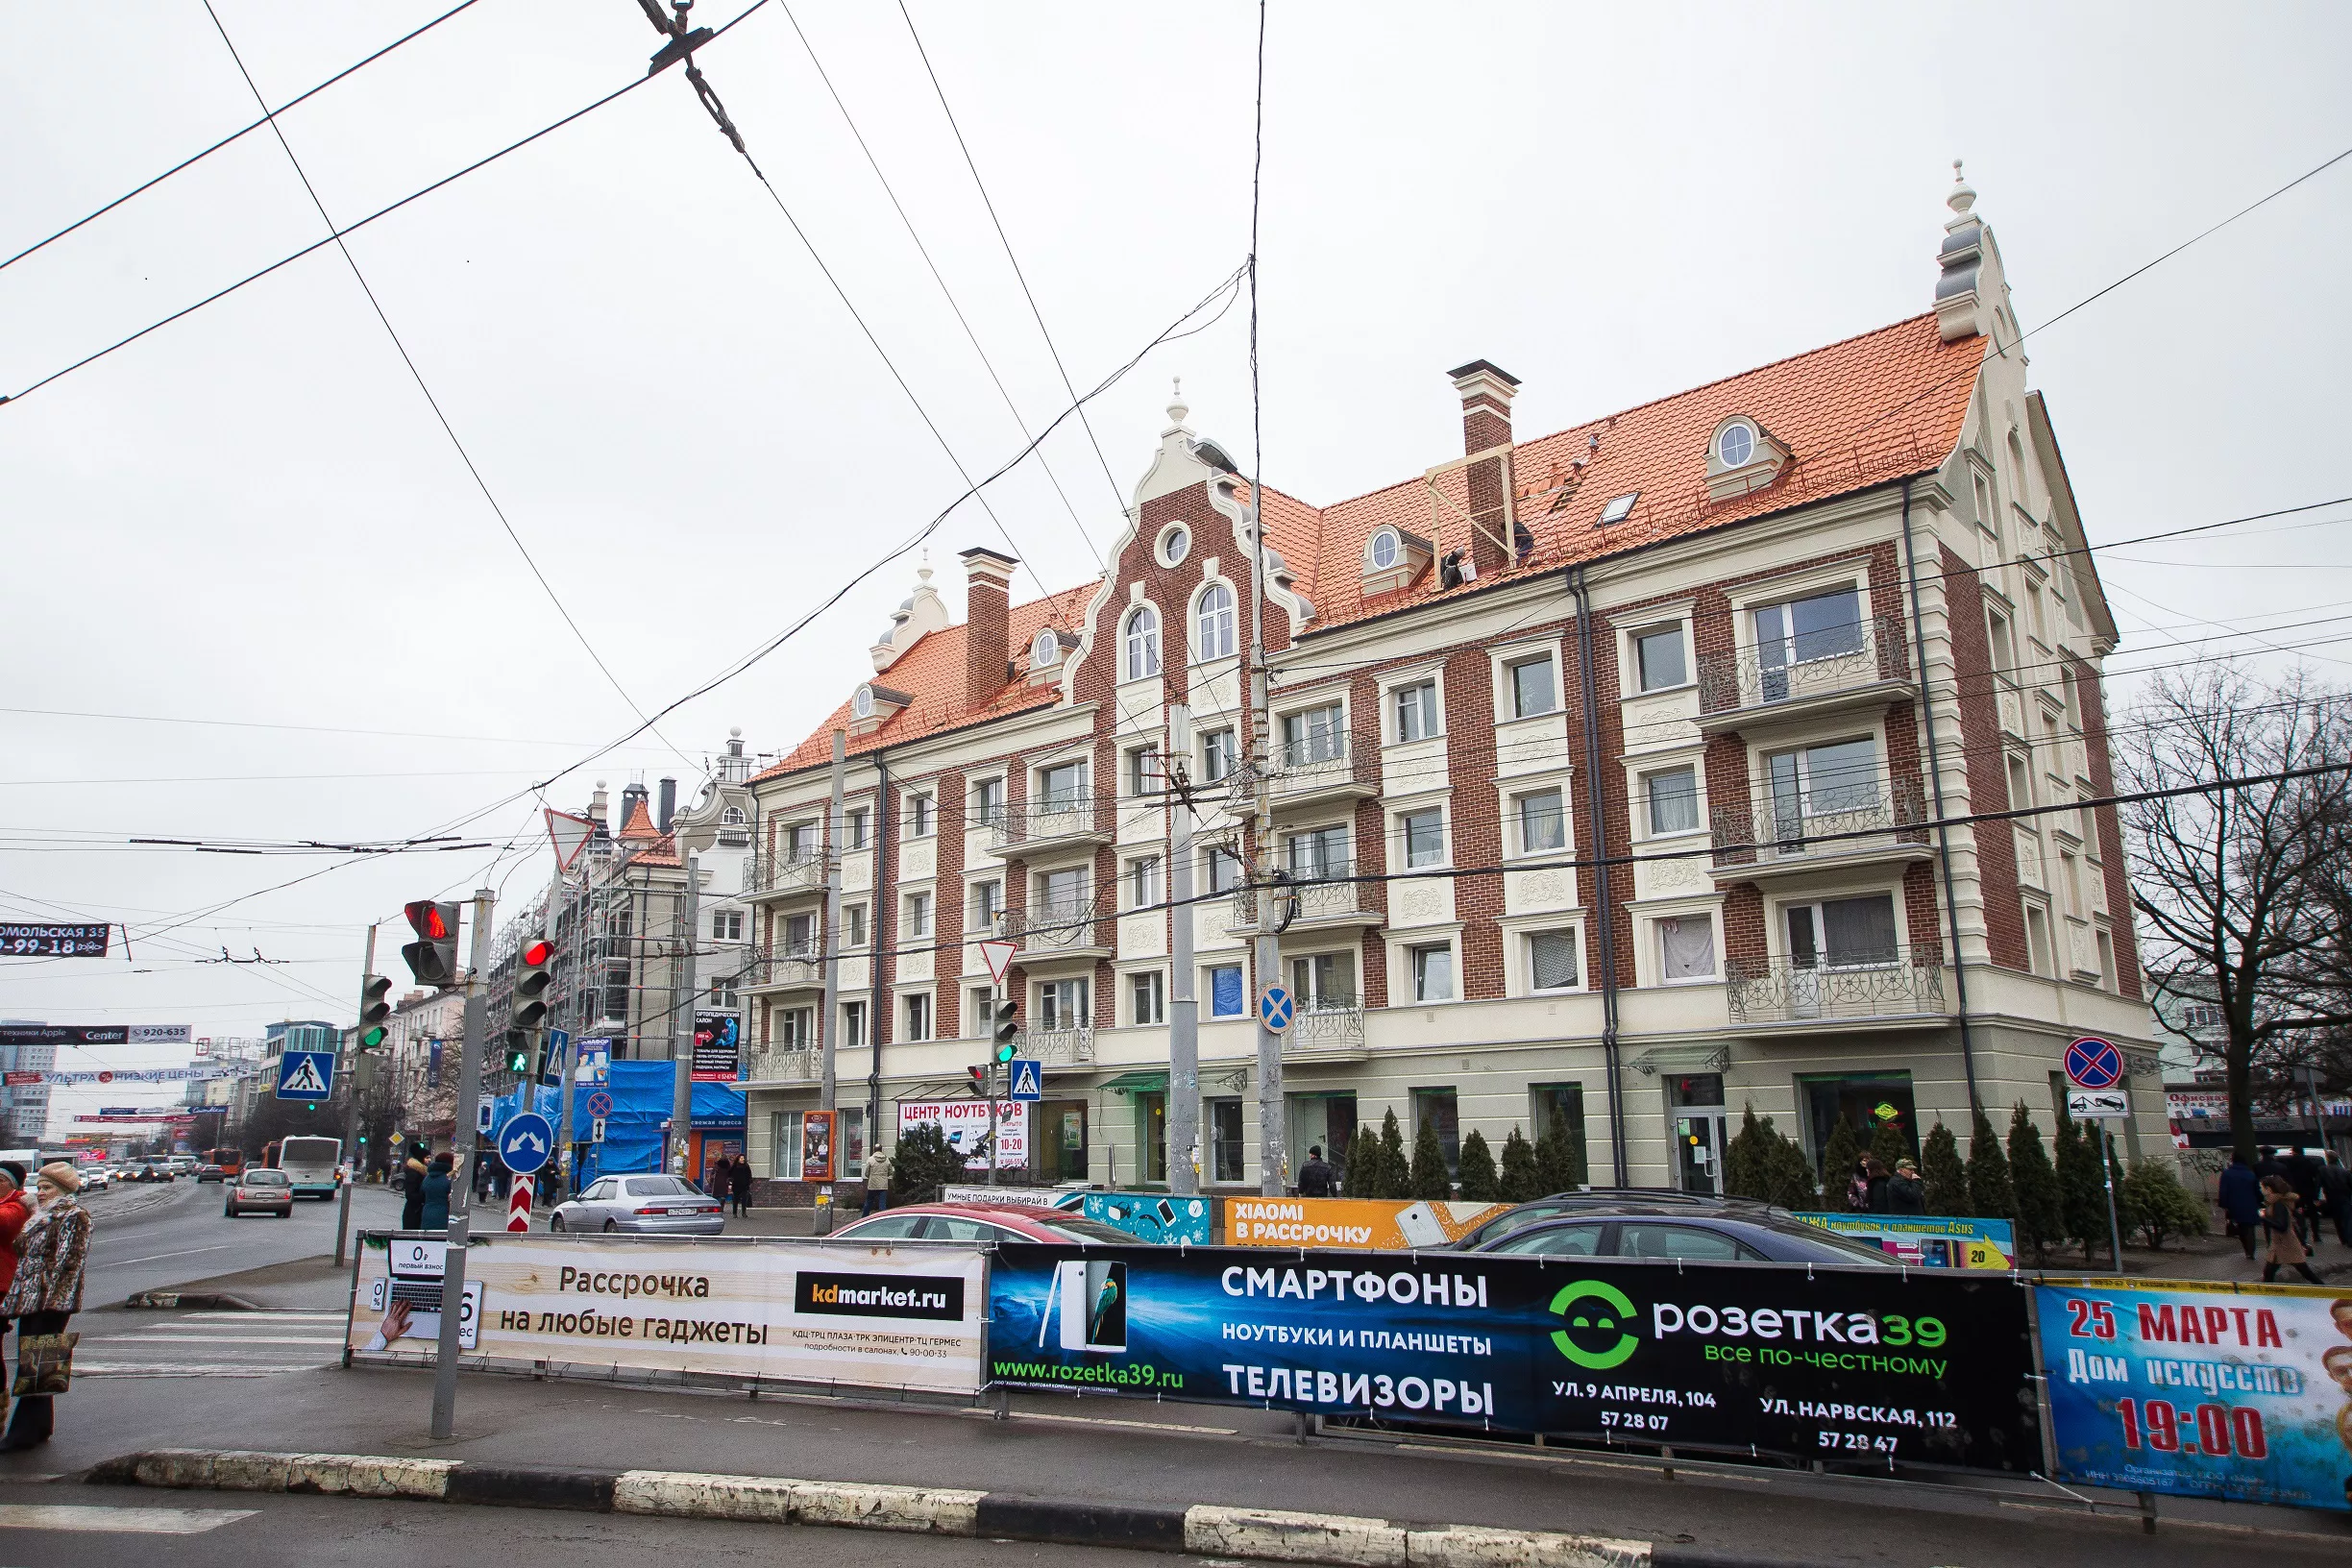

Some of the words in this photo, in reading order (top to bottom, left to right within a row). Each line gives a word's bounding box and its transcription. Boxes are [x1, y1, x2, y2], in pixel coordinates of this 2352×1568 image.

[88, 927, 106, 938] 35
[40, 1029, 67, 1038] Apple
[86, 1031, 124, 1041] Center
[143, 1028, 186, 1037] 920-635
[46, 1073, 96, 1082] УЛЬТРА
[114, 1071, 165, 1081] НИЗКИЕ
[168, 1070, 204, 1080] ЦЕНЫ
[904, 1106, 941, 1121] ЦЕНТР
[1000, 1139, 1022, 1150] 10-20
[946, 1193, 971, 1202] УМНЫЕ
[972, 1194, 1005, 1203] ПОДАРКИ
[1006, 1195, 1043, 1206] ВЫБИРАЙ
[1236, 1203, 1304, 1221] XIAOMI
[1236, 1222, 1248, 1238] В
[1253, 1223, 1372, 1244] РАССРОЧКУ
[1830, 1220, 1880, 1233] ноутбуков
[1883, 1223, 1889, 1232] и
[1891, 1223, 1946, 1234] планшетов
[413, 1246, 423, 1261] 0
[1971, 1250, 1985, 1263] 20
[375, 1284, 382, 1295] 0
[559, 1265, 710, 1299] Рассрочка
[1221, 1265, 1487, 1308] СМАРТФОНЫ
[812, 1283, 946, 1309] kdmarket.ru
[461, 1292, 473, 1322] 6
[459, 1328, 473, 1337] ес
[501, 1310, 530, 1331] на
[538, 1310, 633, 1338] любые
[644, 1316, 769, 1345] гаджеты
[1653, 1302, 1948, 1347] розетка39
[2067, 1298, 2117, 1340] 25
[2137, 1302, 2283, 1348] МАРТА
[929, 1337, 962, 1347] ГЕРМЕС
[1222, 1321, 1335, 1346] НОУТБУКИ
[1338, 1329, 1355, 1346] И
[1360, 1330, 1491, 1356] ПЛАНШЕТЫ
[804, 1343, 856, 1353] подробности
[865, 1348, 899, 1357] салонах,
[1705, 1345, 1752, 1362] все
[1759, 1349, 1948, 1379] по-честному
[2067, 1347, 2129, 1384] Дом
[2145, 1359, 2302, 1396] искусств
[993, 1361, 1184, 1388] www.rozetka39.ru
[1222, 1363, 1494, 1415] ТЕЛЕВИЗОРЫ
[1553, 1381, 1585, 1398] УЛ.
[1586, 1384, 1597, 1399] 9
[1601, 1384, 1683, 1408] АПРЕЛЯ,
[1685, 1390, 1716, 1408] 104
[1601, 1411, 1622, 1427] 57
[1624, 1413, 1646, 1429] 28
[1649, 1415, 1669, 1431] 07
[1759, 1397, 1795, 1416] УЛ.
[1799, 1402, 1923, 1427] НАРВСКАЯ,
[1926, 1410, 1956, 1429] 112
[2116, 1397, 2268, 1459] 19:00
[1819, 1432, 1841, 1448] 57
[1845, 1434, 1869, 1451] 28
[1874, 1437, 1898, 1454] 47
